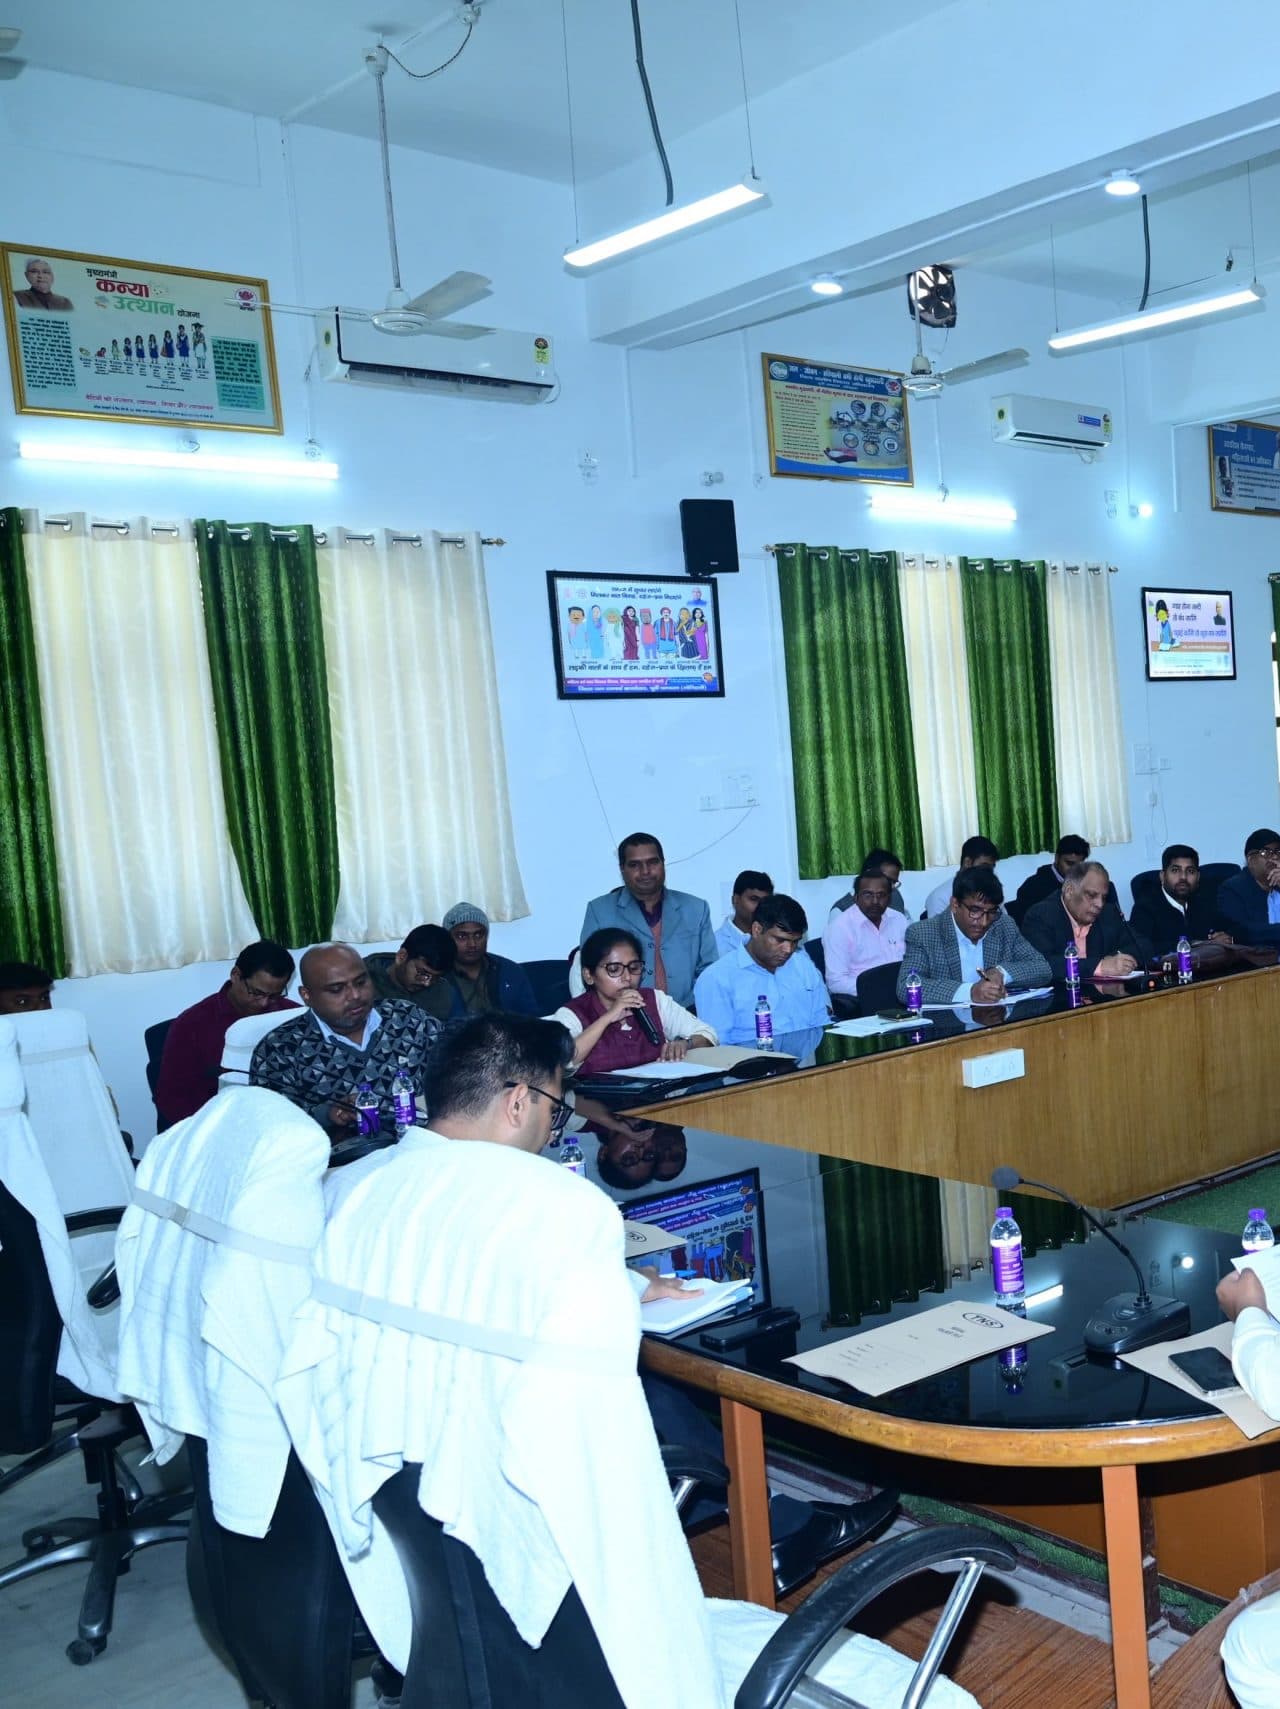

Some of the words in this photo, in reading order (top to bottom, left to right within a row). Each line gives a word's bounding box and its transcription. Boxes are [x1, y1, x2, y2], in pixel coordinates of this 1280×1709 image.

[86, 268, 118, 279] मुख्यमंत्री
[96, 278, 149, 298] कन्या
[112, 295, 175, 316] उत्थान
[176, 308, 200, 318] योजना
